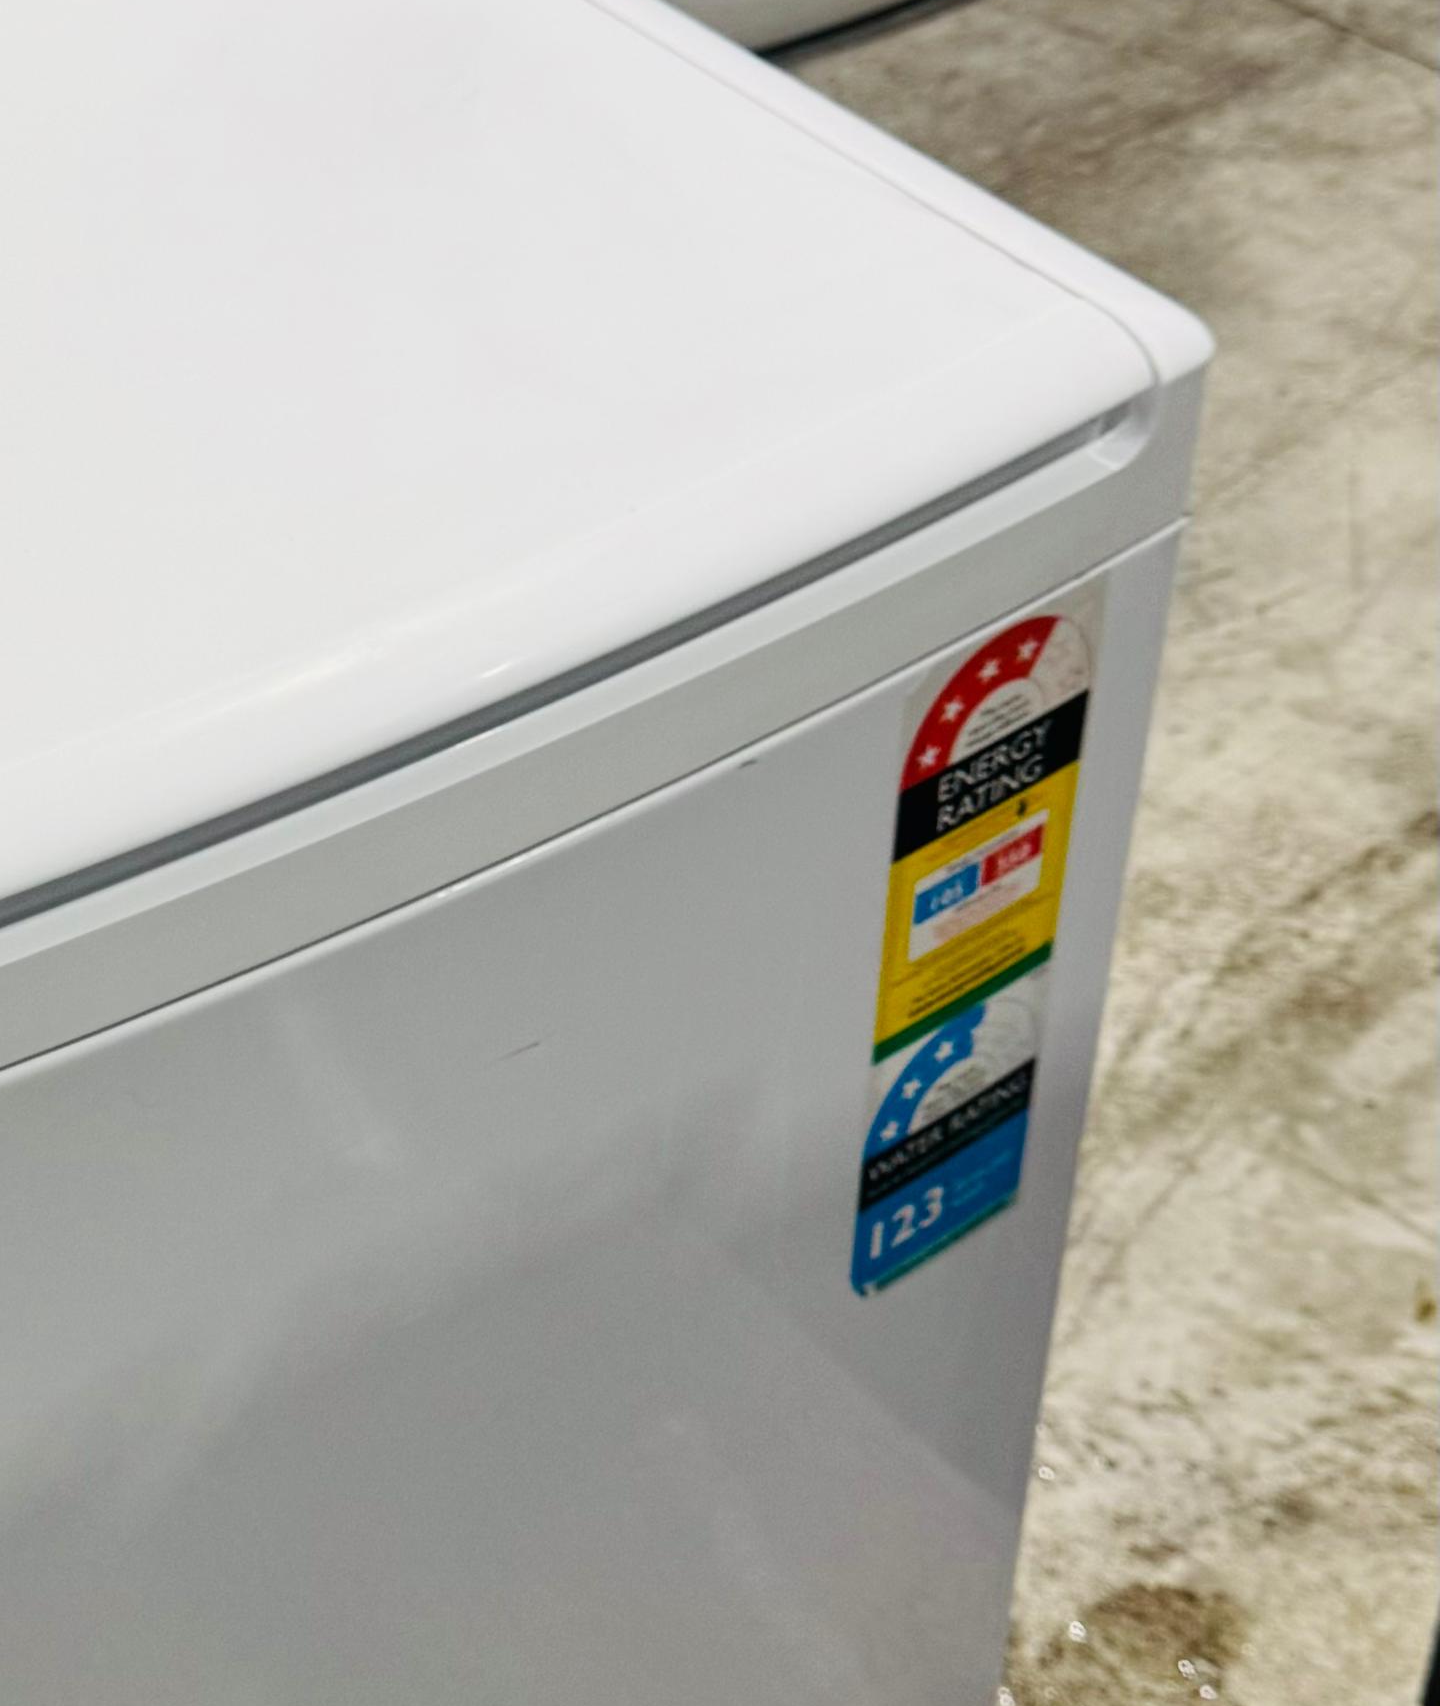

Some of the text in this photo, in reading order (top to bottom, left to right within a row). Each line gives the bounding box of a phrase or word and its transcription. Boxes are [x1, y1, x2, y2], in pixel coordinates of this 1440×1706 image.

[935, 753, 1044, 833] RATING
[936, 718, 1053, 804] ENERGY
[869, 1185, 945, 1261] 123
